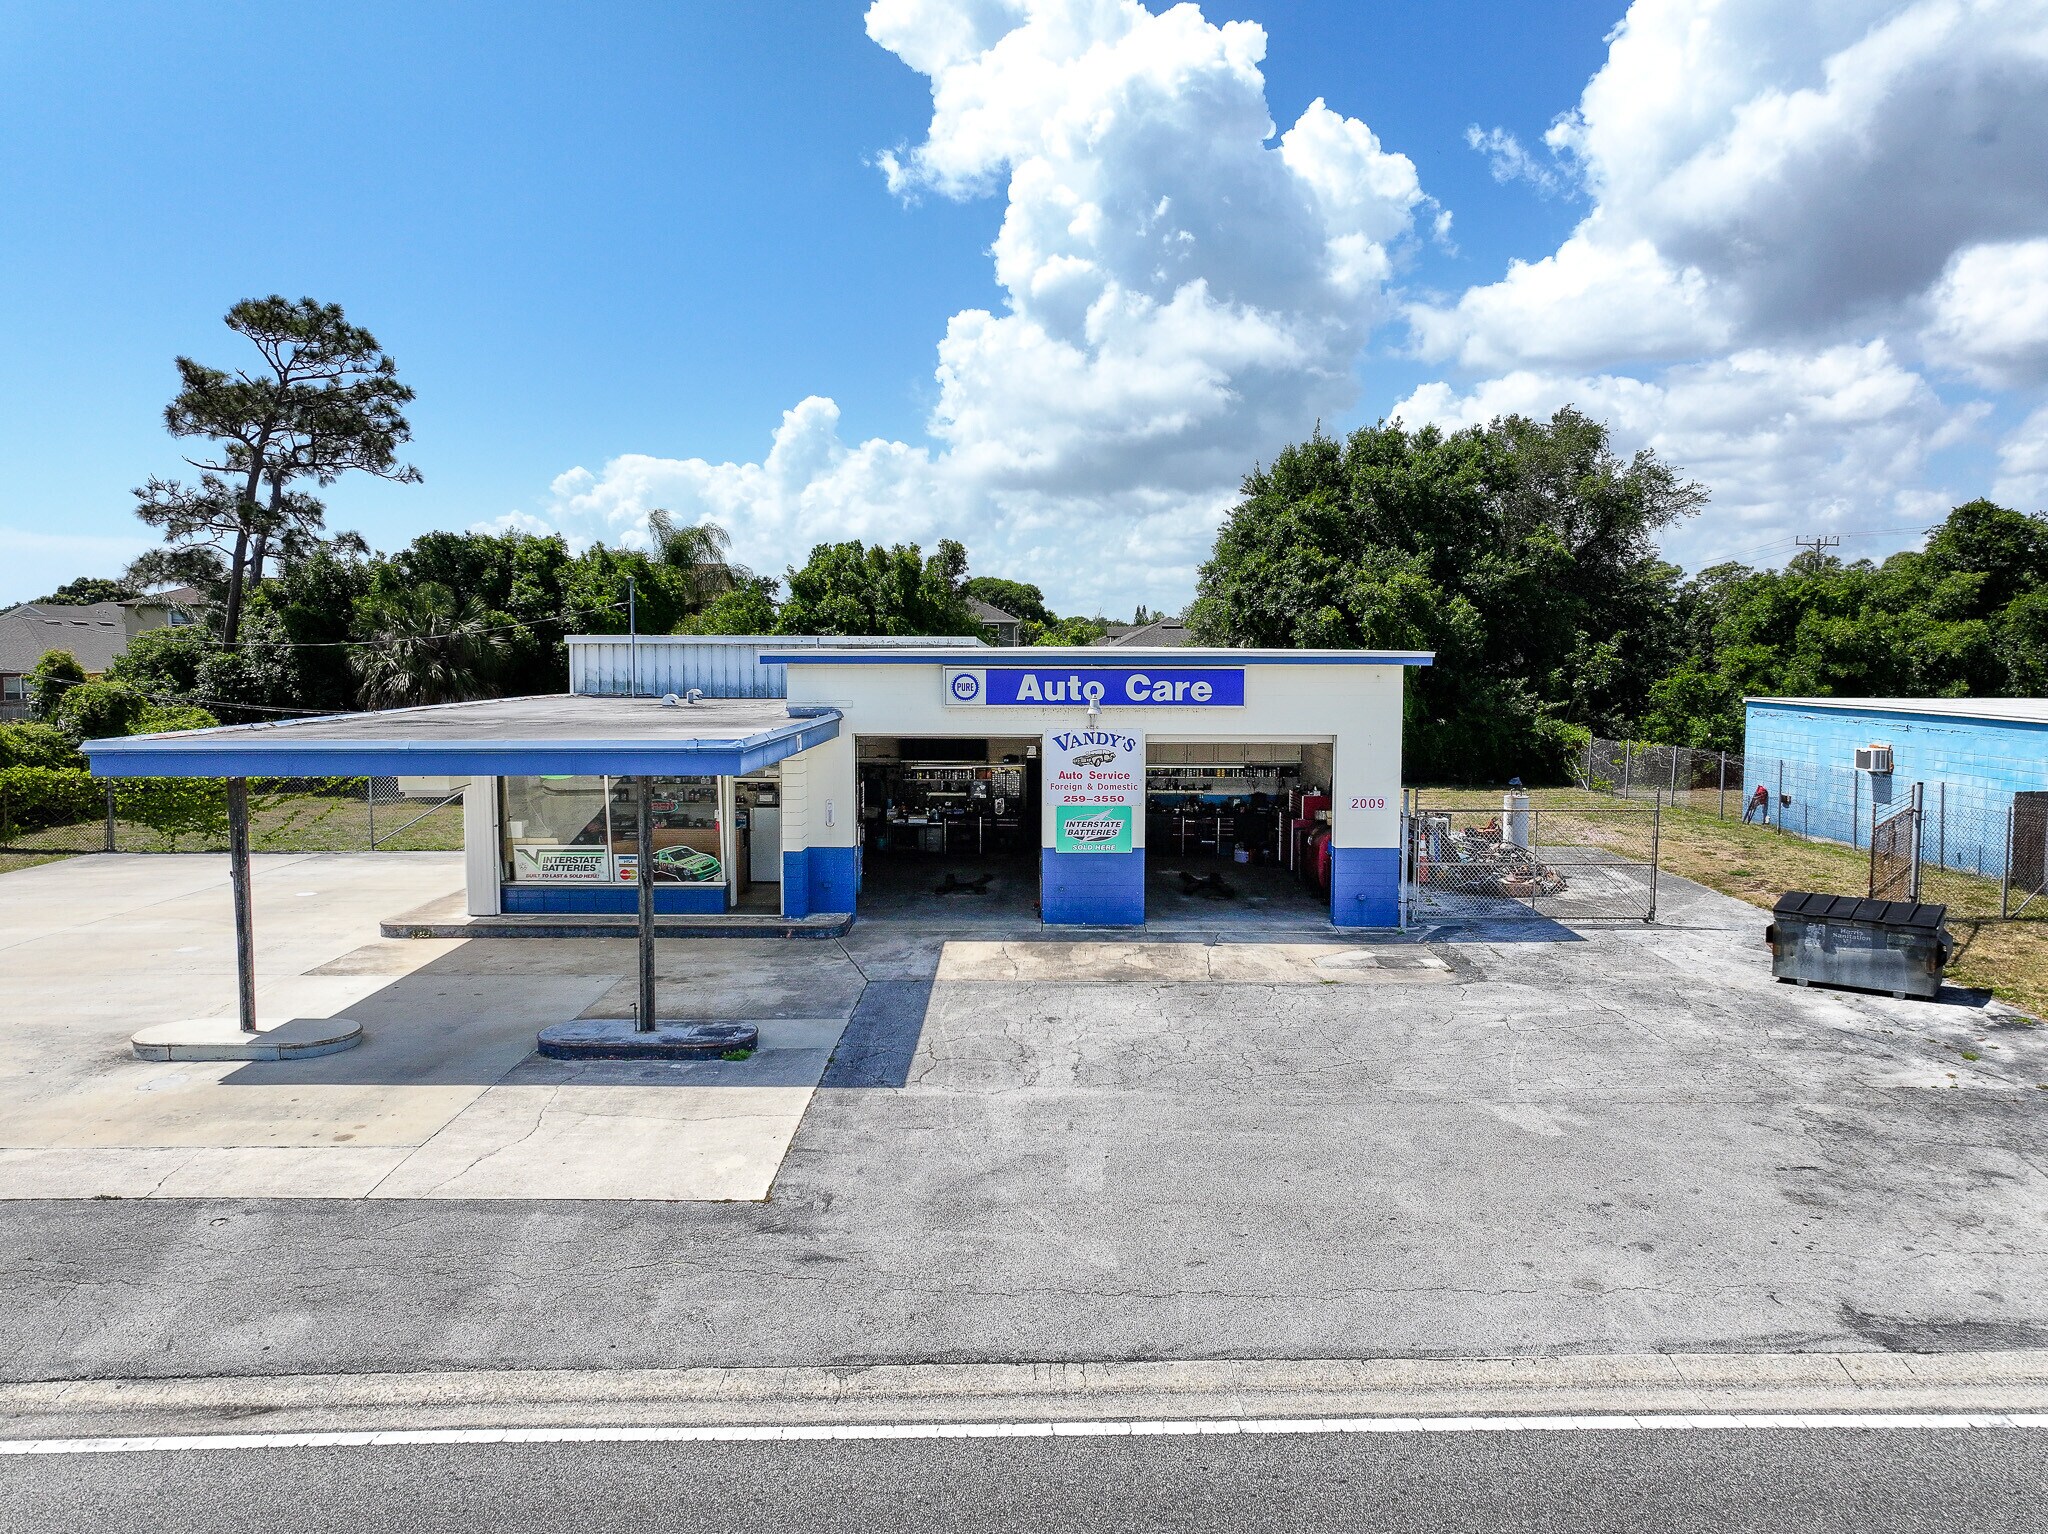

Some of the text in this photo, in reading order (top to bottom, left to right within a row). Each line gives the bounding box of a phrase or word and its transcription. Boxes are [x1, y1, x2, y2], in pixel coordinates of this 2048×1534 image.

[956, 682, 975, 692] PURE
[1016, 673, 1213, 702] Auto Care
[1052, 731, 1136, 752] VANDY'S
[1058, 770, 1131, 780] Auto Service
[1050, 782, 1082, 792] Foreign
[1097, 782, 1138, 791] Domestic
[1063, 795, 1125, 803] 259-3550
[1351, 798, 1385, 809] 2009
[542, 856, 602, 864] INTERSTATE
[541, 864, 596, 872] BATTERIES
